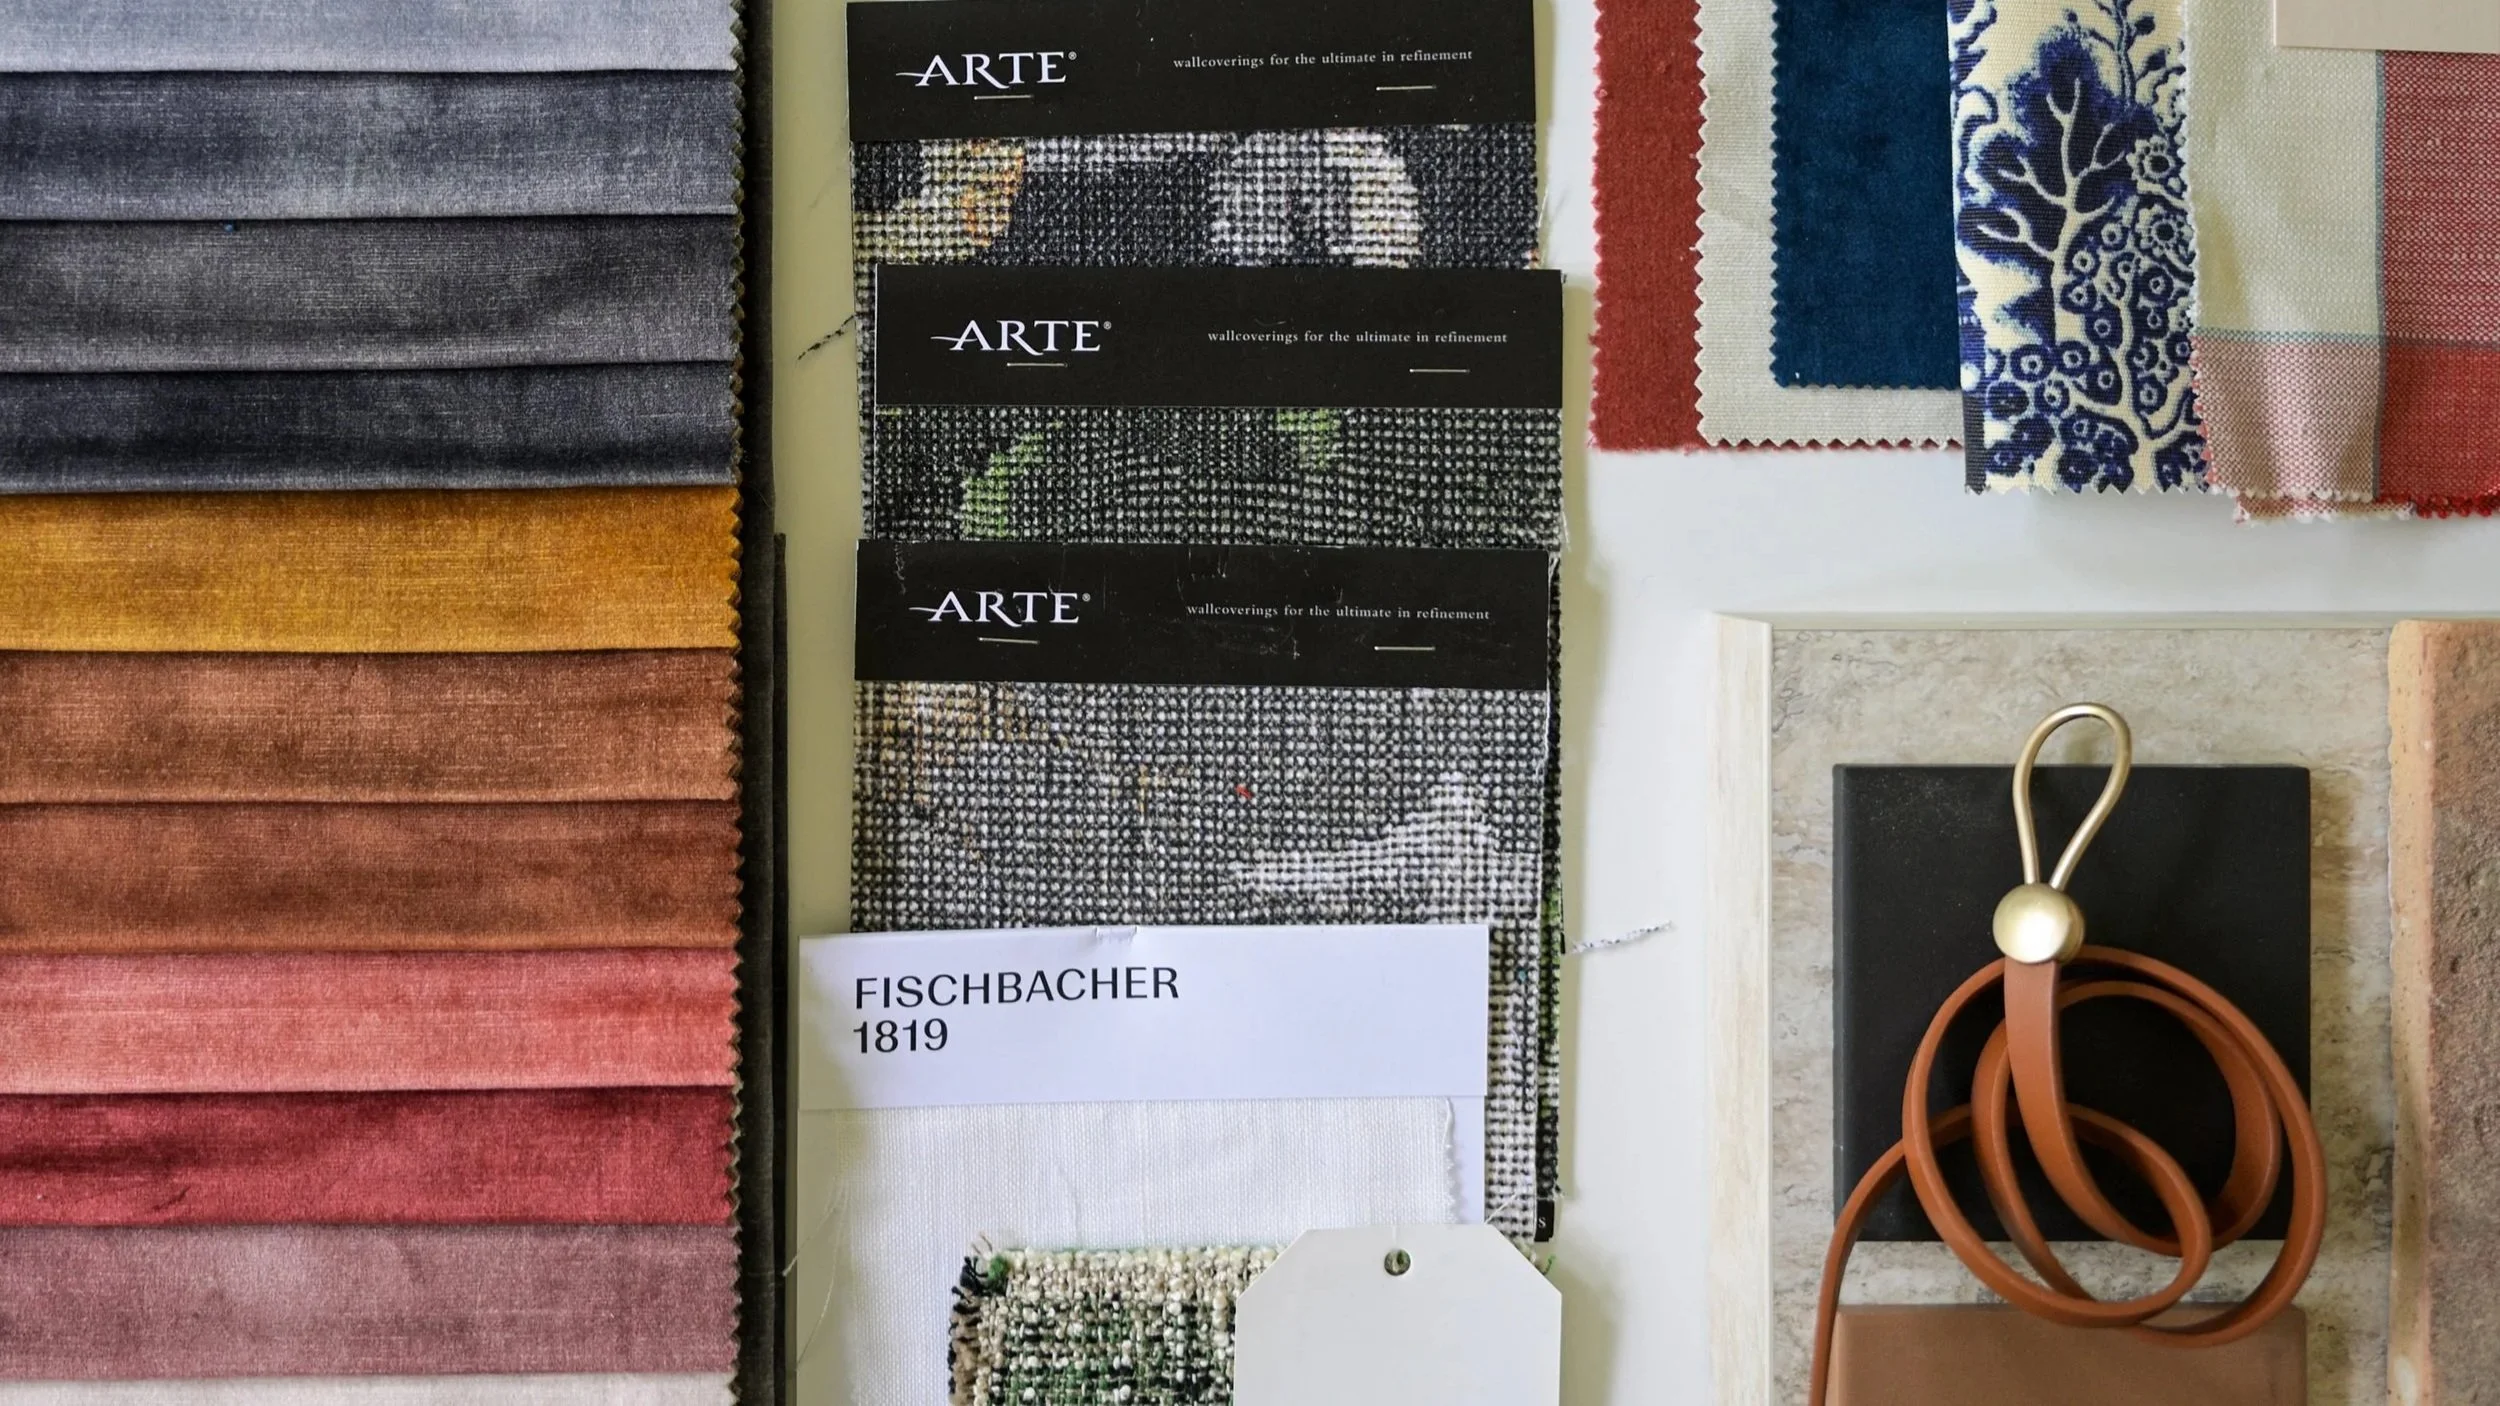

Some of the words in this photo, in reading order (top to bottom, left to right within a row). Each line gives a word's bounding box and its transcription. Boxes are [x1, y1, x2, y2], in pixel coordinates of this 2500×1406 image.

[1173, 55, 1265, 69] wallcoverings
[1270, 53, 1289, 65] for
[1295, 53, 1316, 65] the
[1322, 52, 1376, 64] ultimate
[1382, 52, 1394, 62] in
[1400, 49, 1472, 62] refinement
[1207, 330, 1299, 345] wallcoverings
[1304, 330, 1324, 342] for
[1329, 330, 1350, 342] the
[1356, 330, 1411, 342] ultimate
[1417, 331, 1429, 342] in
[1435, 331, 1507, 343] refinement
[1187, 604, 1279, 618] wallcoverings
[1284, 605, 1303, 616] for
[1309, 605, 1330, 617] the
[1336, 605, 1392, 618] ultimate
[1398, 607, 1410, 618] in
[1416, 607, 1490, 619] refinement
[856, 967, 1179, 1010] FISCHBACHER
[853, 1018, 948, 1054] 1819
